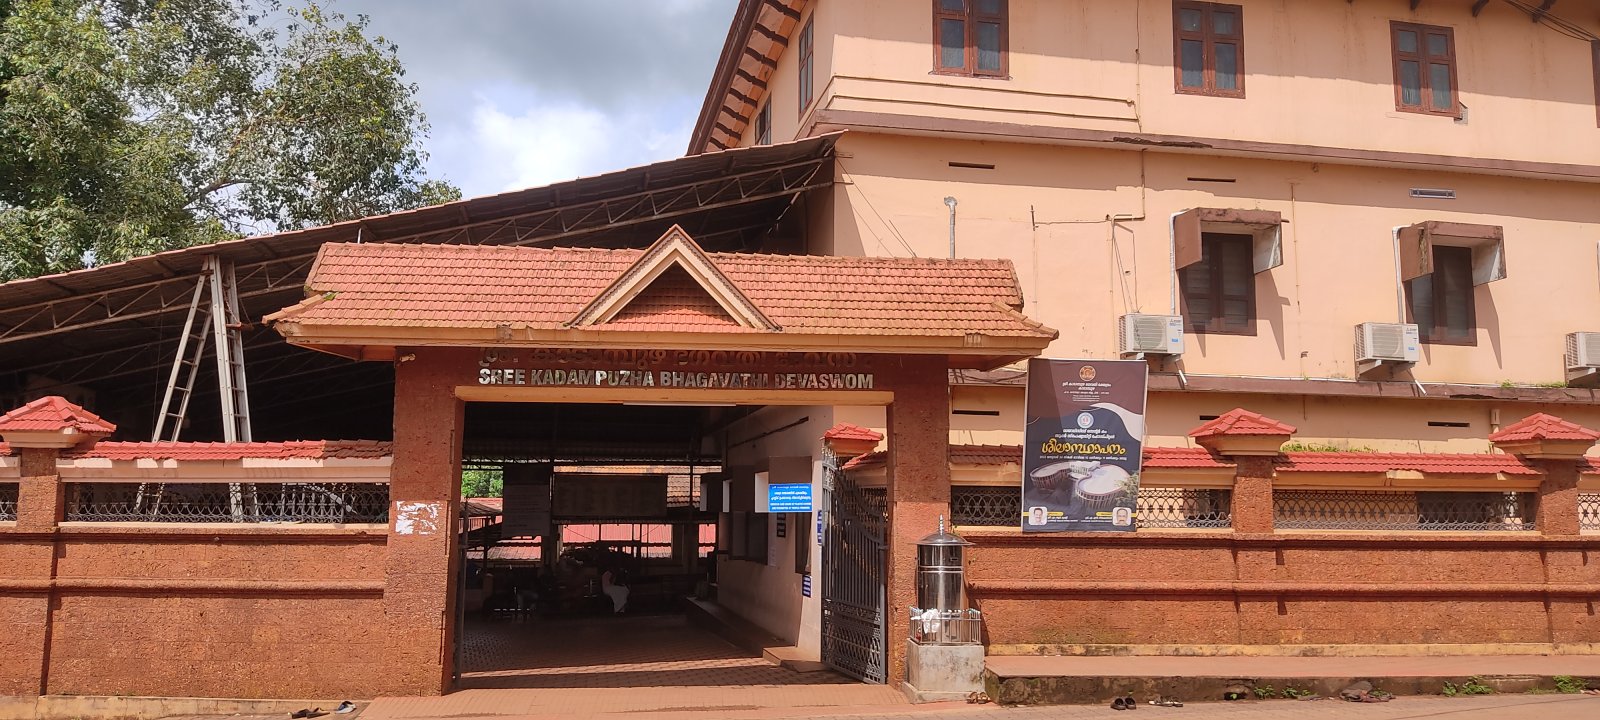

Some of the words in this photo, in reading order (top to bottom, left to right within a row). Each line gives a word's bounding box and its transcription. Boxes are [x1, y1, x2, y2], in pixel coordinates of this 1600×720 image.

[478, 368, 526, 386] SREE
[530, 370, 655, 387] KADAMPUZHA
[659, 371, 769, 389] BHAGAVATHI
[774, 373, 874, 390] DEVASWOM
